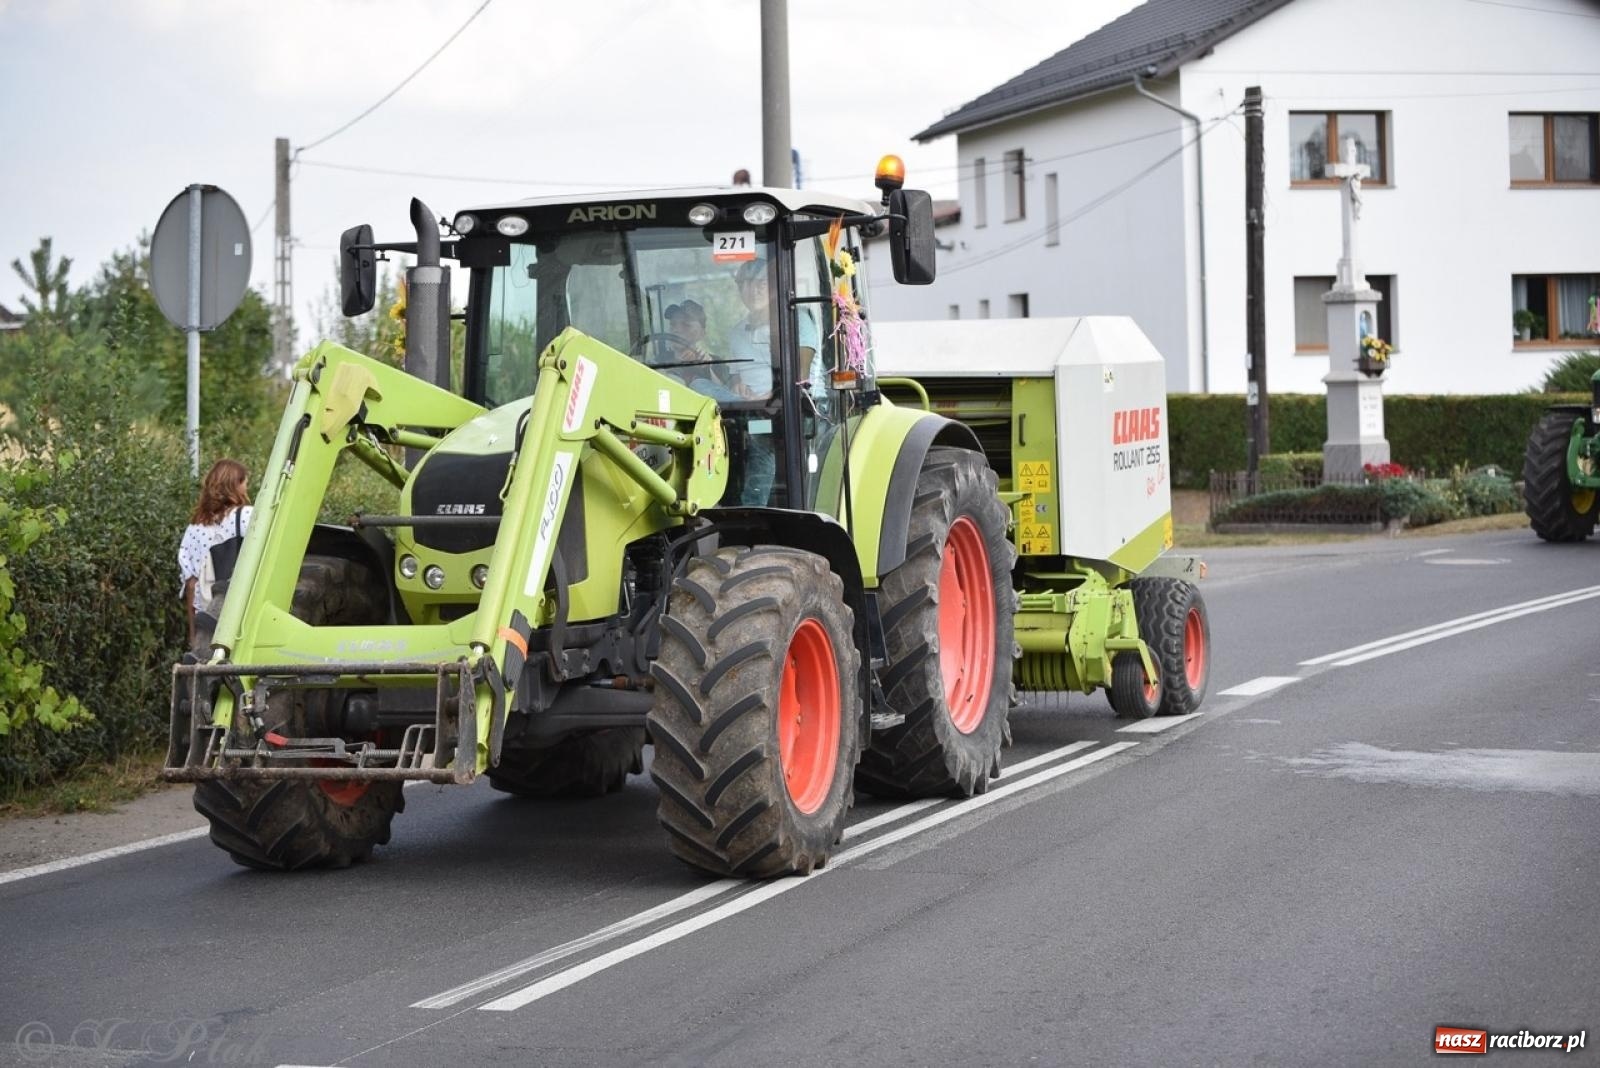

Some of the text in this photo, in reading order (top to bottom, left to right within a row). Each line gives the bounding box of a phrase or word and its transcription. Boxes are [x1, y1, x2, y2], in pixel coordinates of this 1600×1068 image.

[567, 204, 657, 223] ARION
[719, 237, 745, 249] 271
[566, 360, 585, 430] CLAAS
[1113, 407, 1160, 445] CLAAS
[1113, 445, 1161, 471] ROLLANT 255
[436, 503, 486, 515] CLAAS
